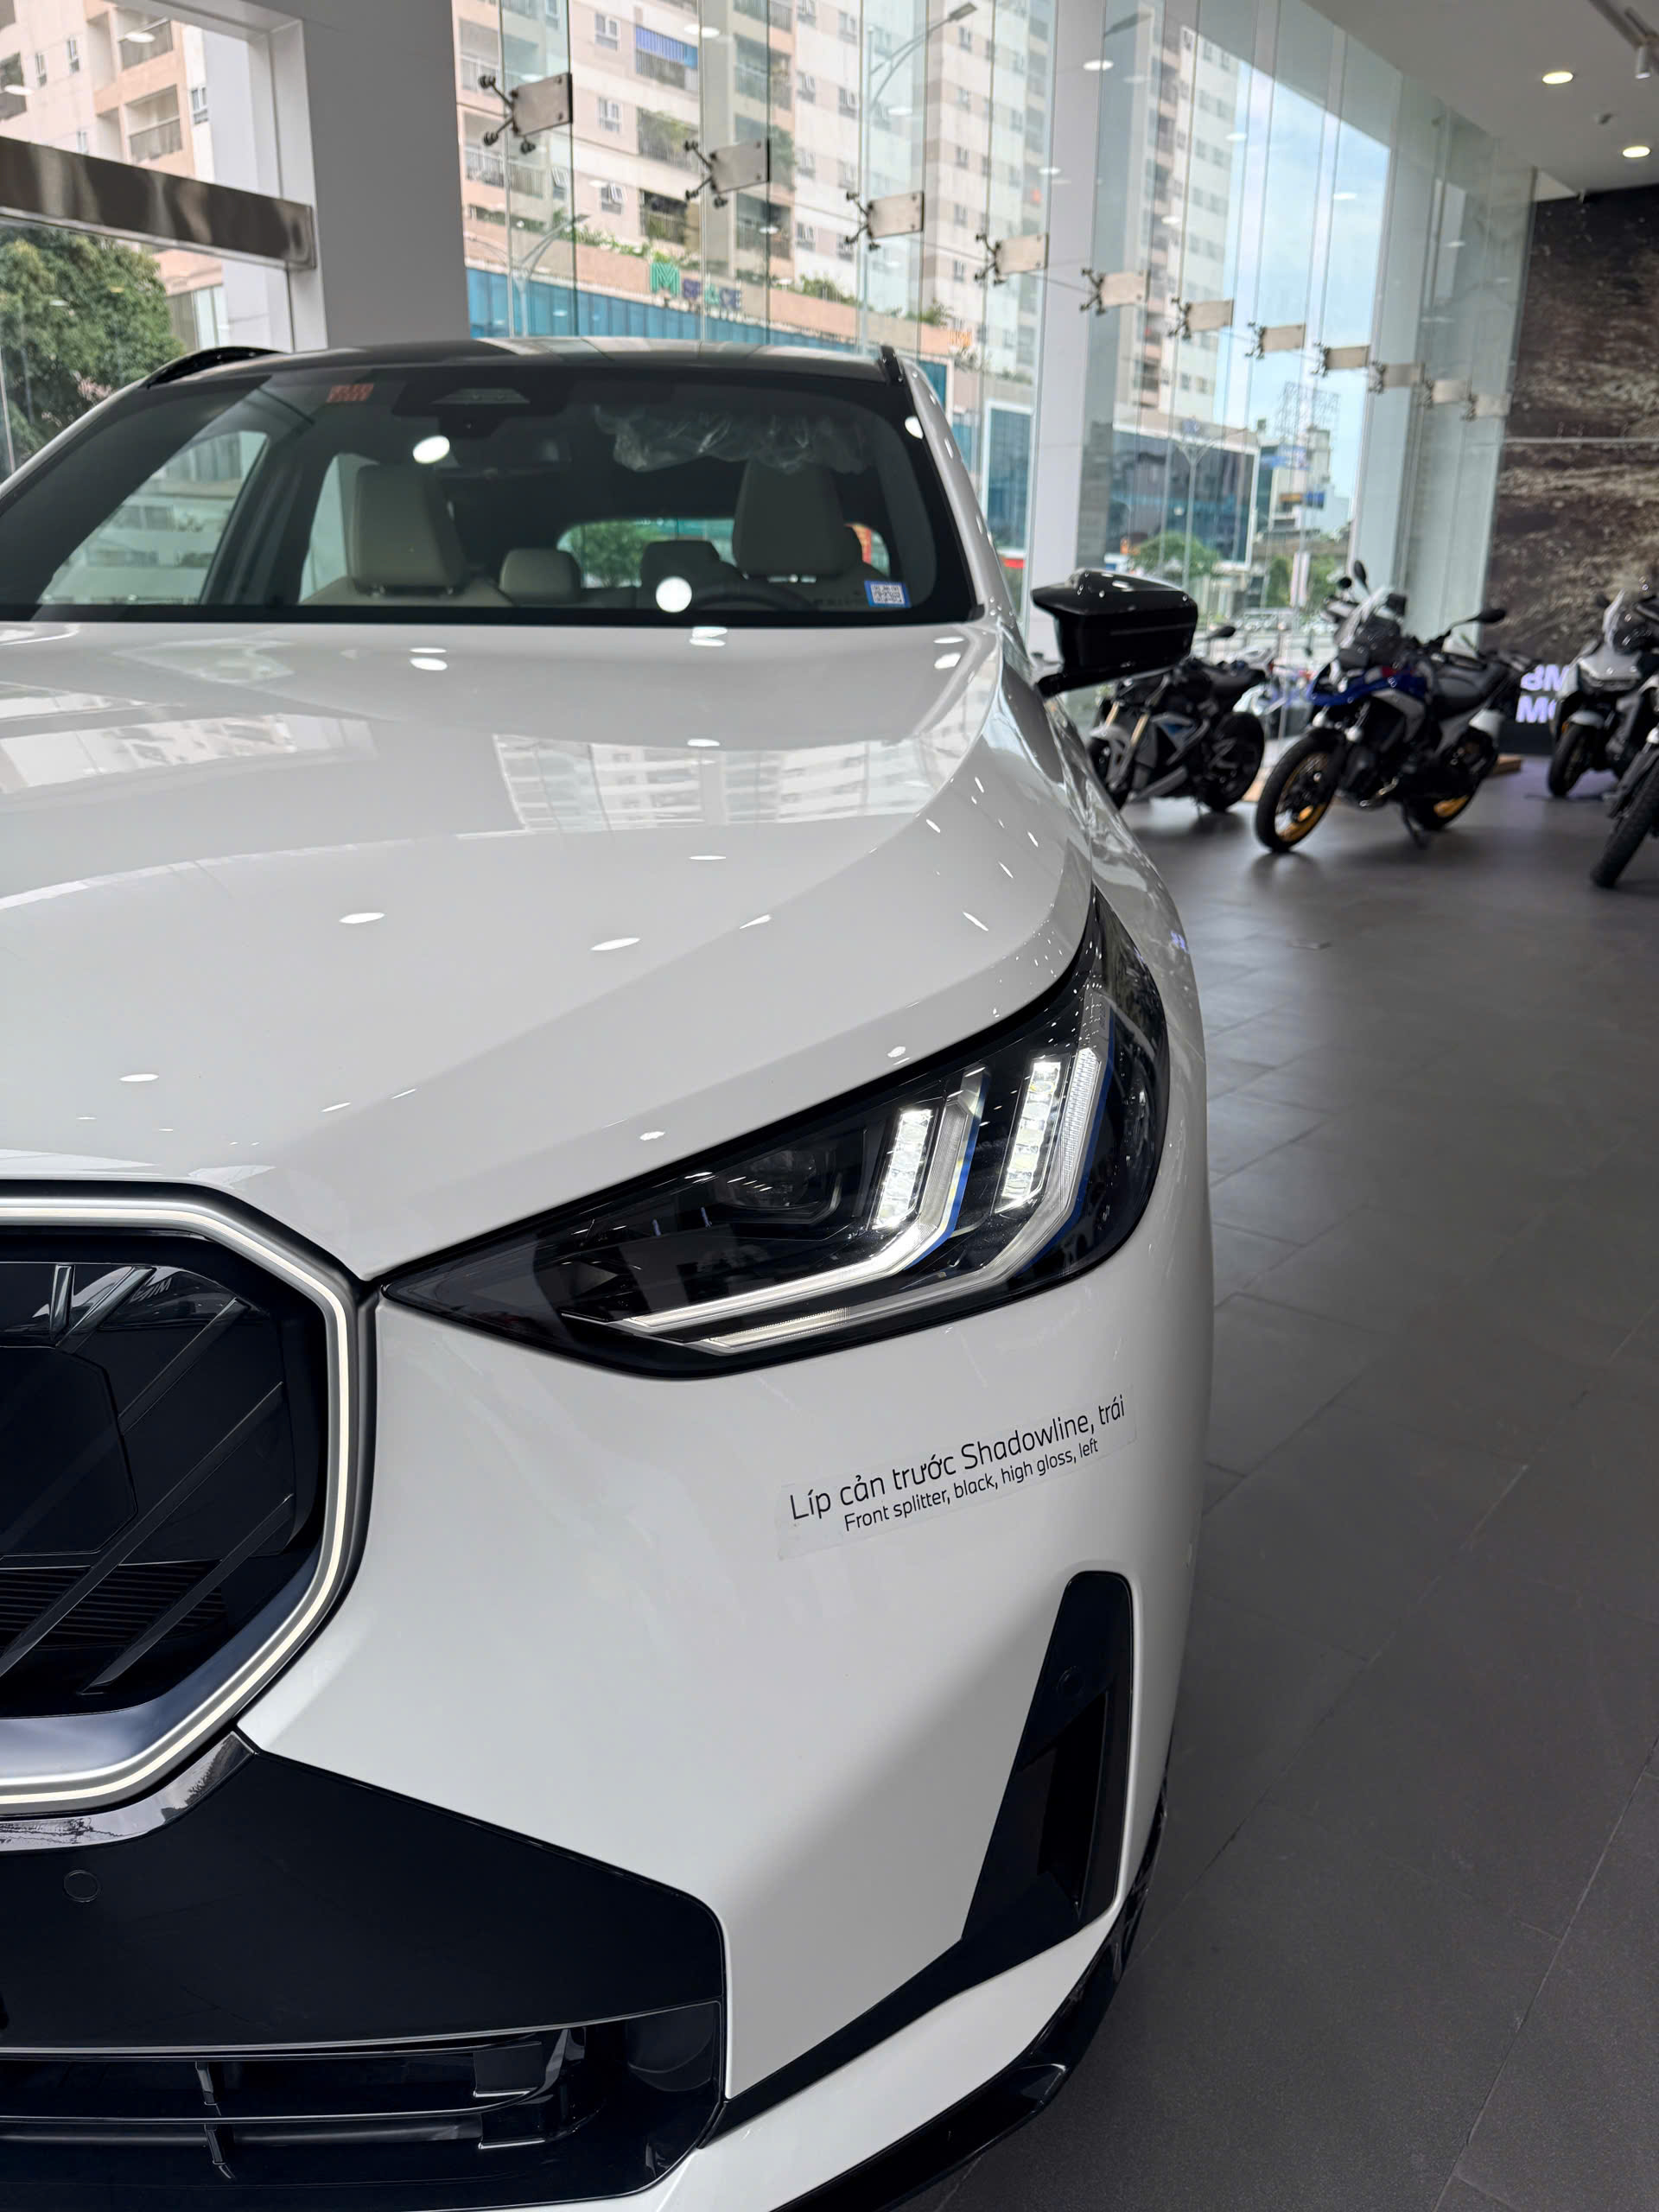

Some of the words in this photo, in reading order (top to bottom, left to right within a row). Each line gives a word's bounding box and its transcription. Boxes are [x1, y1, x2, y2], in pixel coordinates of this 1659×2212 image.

[789, 1488, 831, 1521] Líp
[839, 1474, 886, 1506] cản
[892, 1453, 957, 1491] trước
[960, 1414, 1096, 1471] Shadowline,
[1097, 1394, 1125, 1426] trái
[843, 1505, 890, 1532] Front
[893, 1489, 950, 1519] splitter,
[953, 1472, 999, 1499] black,
[1000, 1460, 1033, 1484] high
[1036, 1450, 1077, 1477] gloss,
[1078, 1437, 1099, 1459] left
